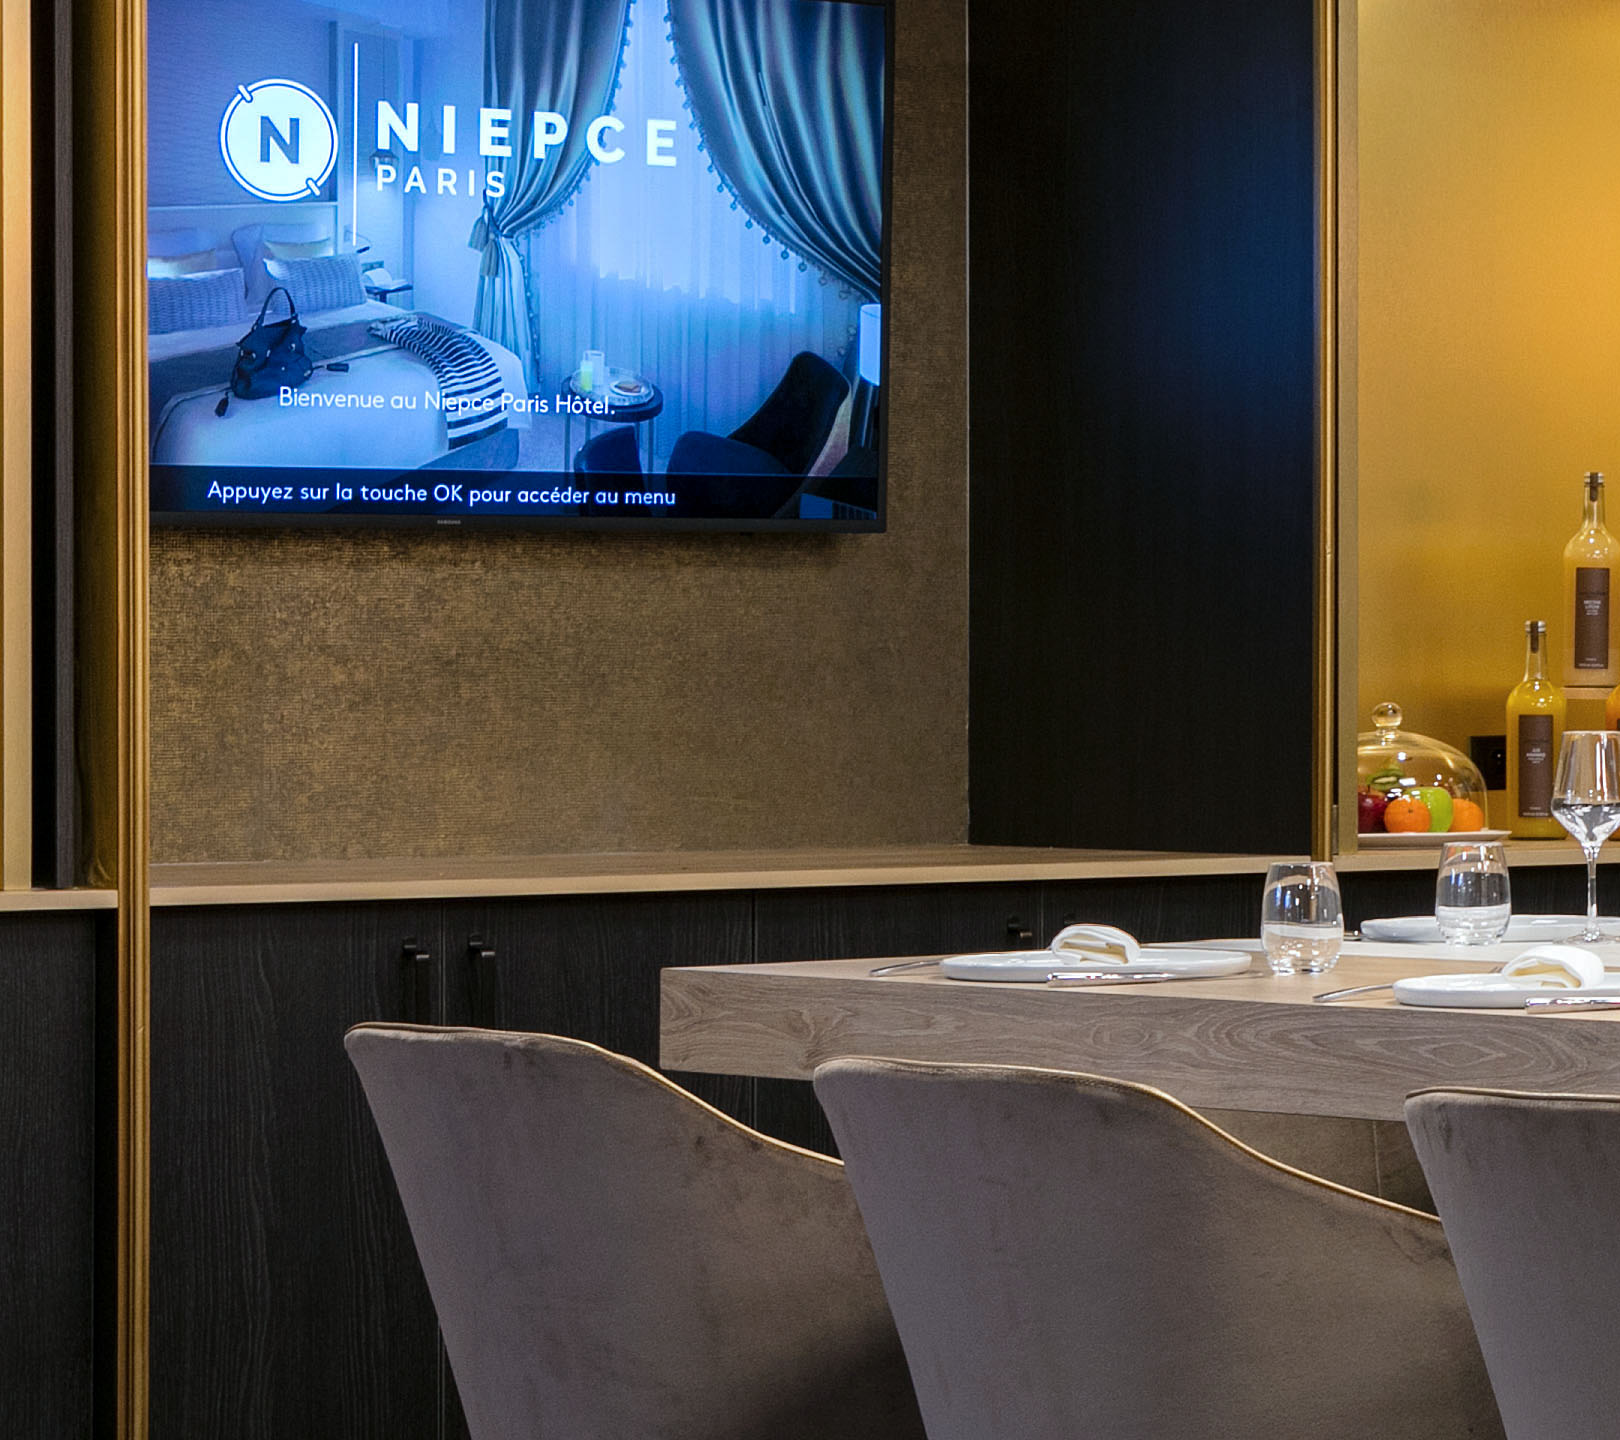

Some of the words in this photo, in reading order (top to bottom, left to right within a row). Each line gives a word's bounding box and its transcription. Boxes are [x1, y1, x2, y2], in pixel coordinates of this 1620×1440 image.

[260, 115, 300, 164] N
[377, 100, 677, 167] NIEPCE
[377, 164, 505, 198] PARIS
[279, 386, 385, 408] Bienvenue
[390, 395, 417, 410] au
[424, 391, 494, 416] Niepce
[501, 392, 549, 413] Paris
[556, 394, 616, 415] Hôtel.
[208, 480, 293, 504] Appuyez
[300, 487, 329, 500] sur
[336, 482, 353, 500] la
[360, 484, 428, 501] touche
[433, 484, 463, 502] OK
[470, 490, 512, 507] pour
[518, 486, 590, 504] accéder
[595, 492, 619, 504] au
[625, 492, 676, 505] menu
